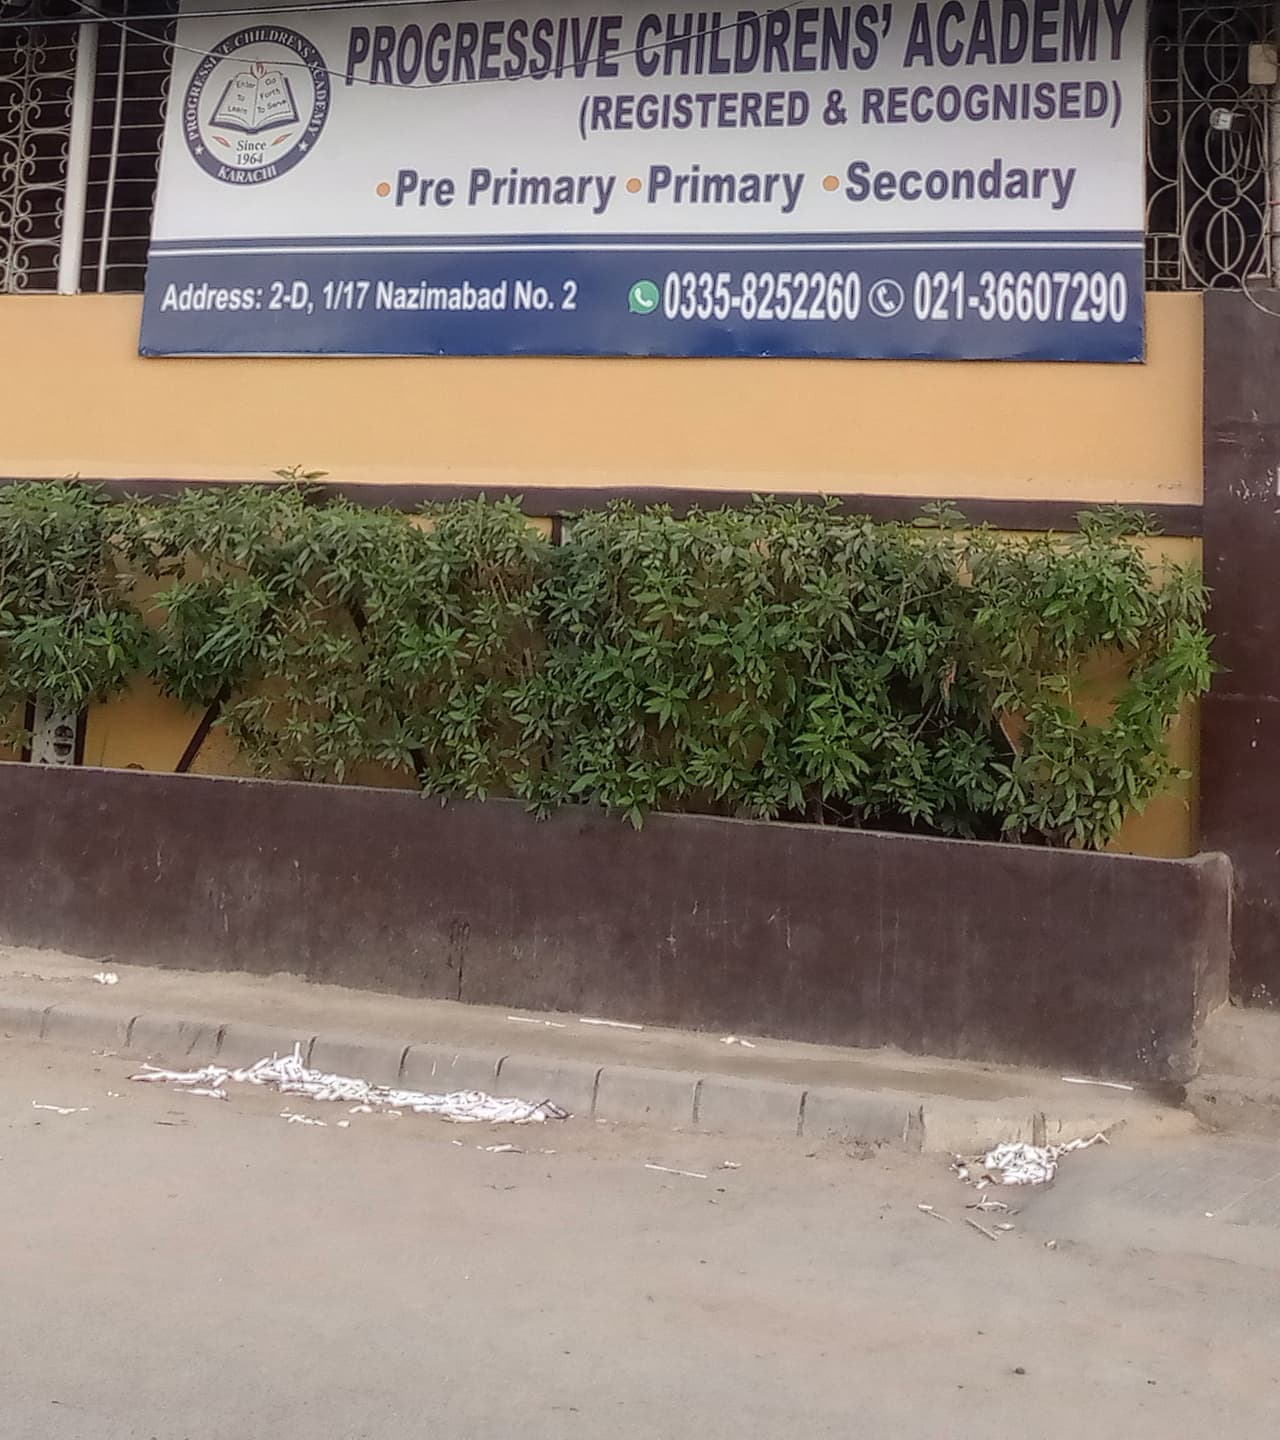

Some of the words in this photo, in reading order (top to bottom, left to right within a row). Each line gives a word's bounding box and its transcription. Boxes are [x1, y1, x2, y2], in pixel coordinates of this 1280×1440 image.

[345, 13, 623, 86] PROGRESSIVE
[578, 89, 810, 140] (REGISTERED
[823, 88, 848, 126] &
[862, 80, 1123, 129] RECOGNISED)
[236, 140, 267, 152] Since
[237, 153, 264, 166] 1964
[218, 165, 277, 183] KARACHI
[394, 169, 455, 207] Pre
[468, 167, 617, 216] Primary
[648, 164, 805, 214] Primary
[845, 159, 1077, 210] Secondary
[160, 281, 263, 312] Address:
[268, 282, 314, 315] 2-D,
[322, 281, 369, 312] 1/17
[376, 279, 506, 312] Nazimabad
[513, 281, 556, 312] No.
[562, 280, 578, 310] 2
[662, 271, 861, 322] 0335-8252260
[912, 270, 1129, 323] 021-36607290
